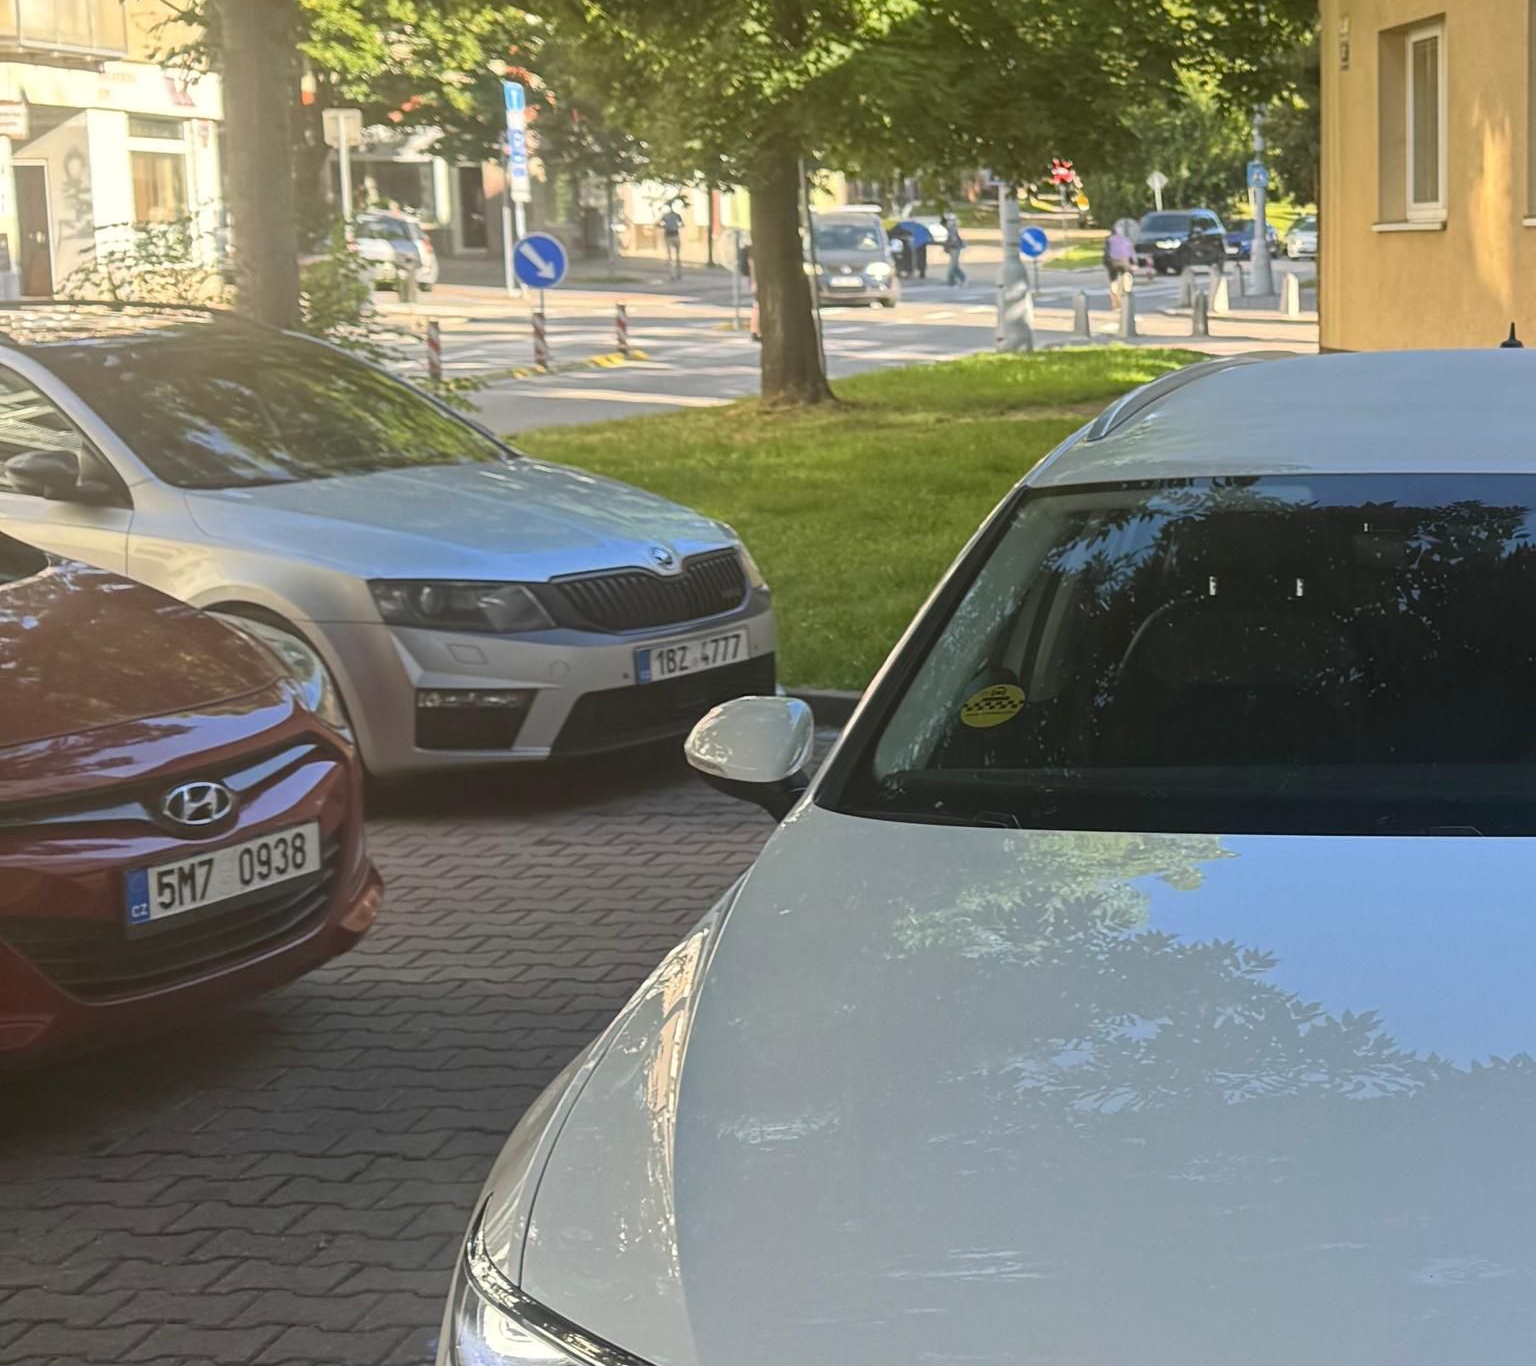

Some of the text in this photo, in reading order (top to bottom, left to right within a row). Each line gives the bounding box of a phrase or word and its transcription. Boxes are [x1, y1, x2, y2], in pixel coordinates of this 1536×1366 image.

[656, 645, 688, 675] 1BZ
[156, 833, 306, 910] 5M7 0938
[131, 903, 149, 918] CZ
